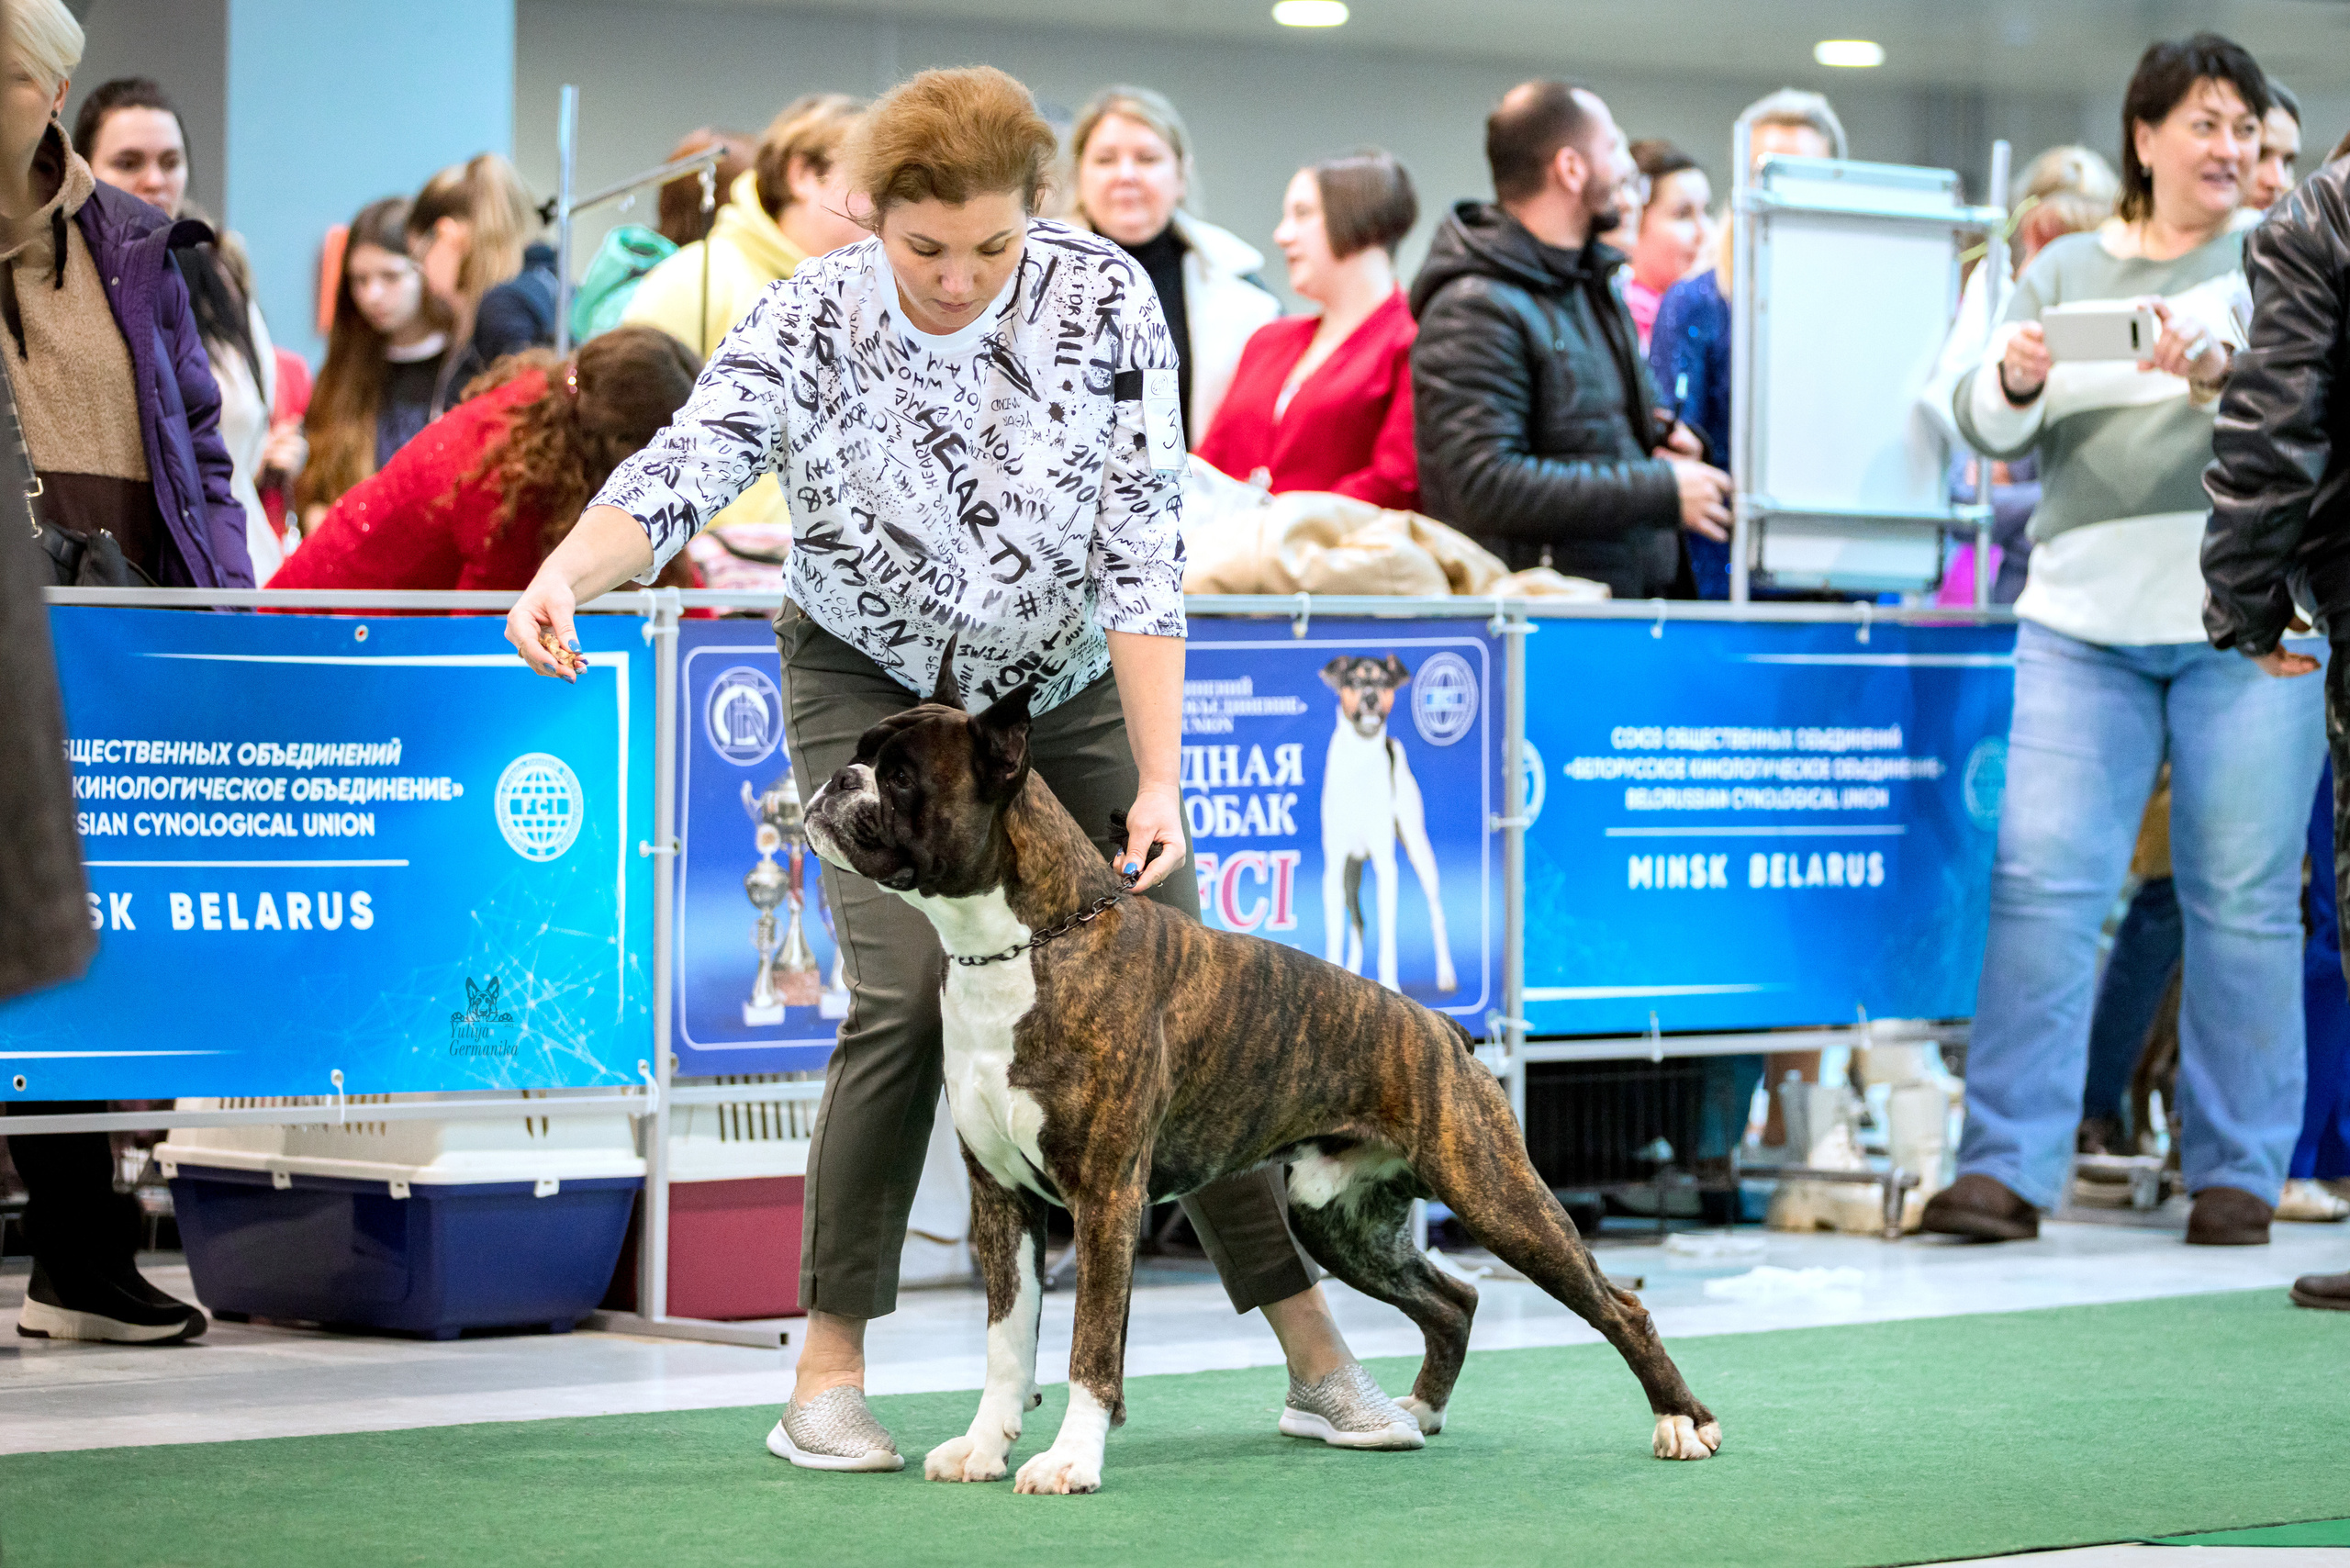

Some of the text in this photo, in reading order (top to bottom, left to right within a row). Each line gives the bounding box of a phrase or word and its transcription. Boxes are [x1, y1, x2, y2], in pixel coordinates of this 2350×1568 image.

[912, 438, 941, 491] HEART
[902, 551, 969, 605] LOVE
[236, 737, 403, 770] ОБЪЕДИНЕНИЙ
[72, 776, 464, 805] КИНОЛОГИЧЕСКОЕ ОБЪЕДИНЕНИЕ»
[76, 812, 375, 837] SIAN CYNOLOGICAL UNION
[1628, 851, 1886, 890] MINSK BELARUS
[84, 890, 375, 931] SK BELARUS
